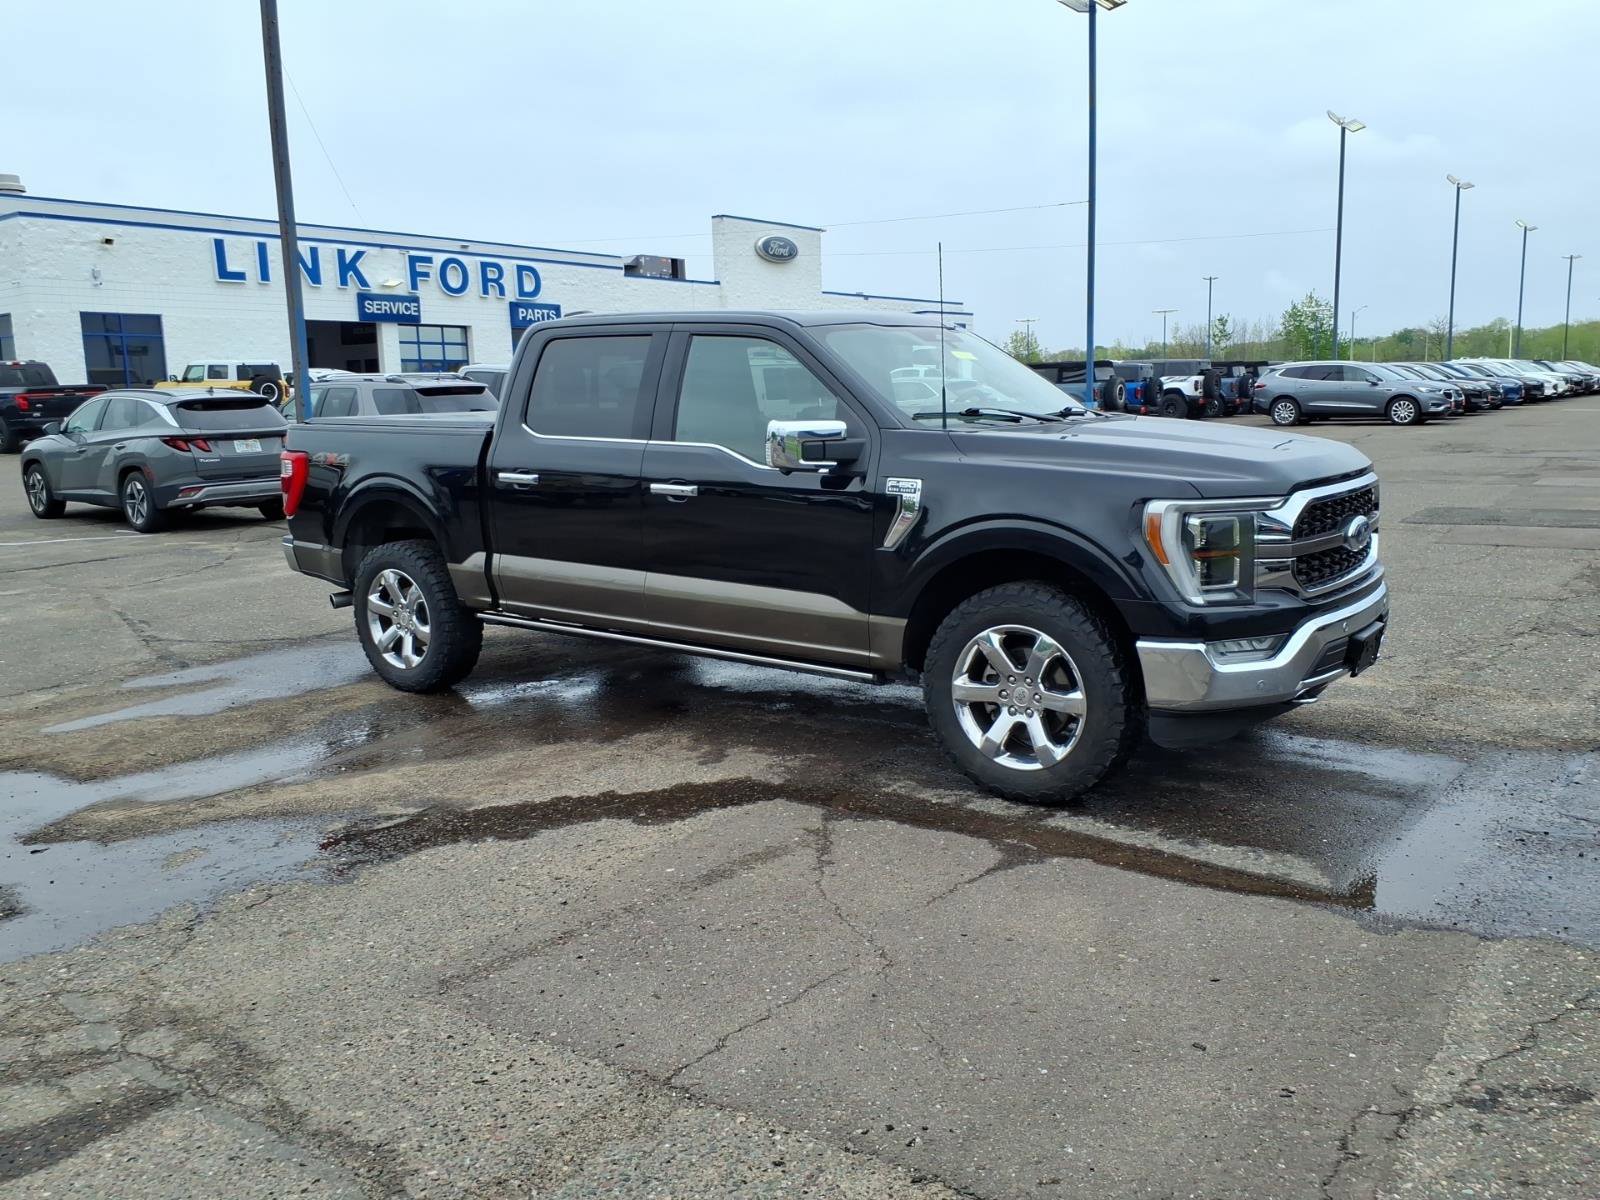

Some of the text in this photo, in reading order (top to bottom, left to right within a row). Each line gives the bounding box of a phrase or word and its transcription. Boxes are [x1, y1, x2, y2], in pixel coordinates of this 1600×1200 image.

[768, 241, 790, 256] Ford
[213, 238, 542, 299] LINK FORD
[364, 300, 419, 315] SERVICE
[518, 308, 557, 321] PARTS
